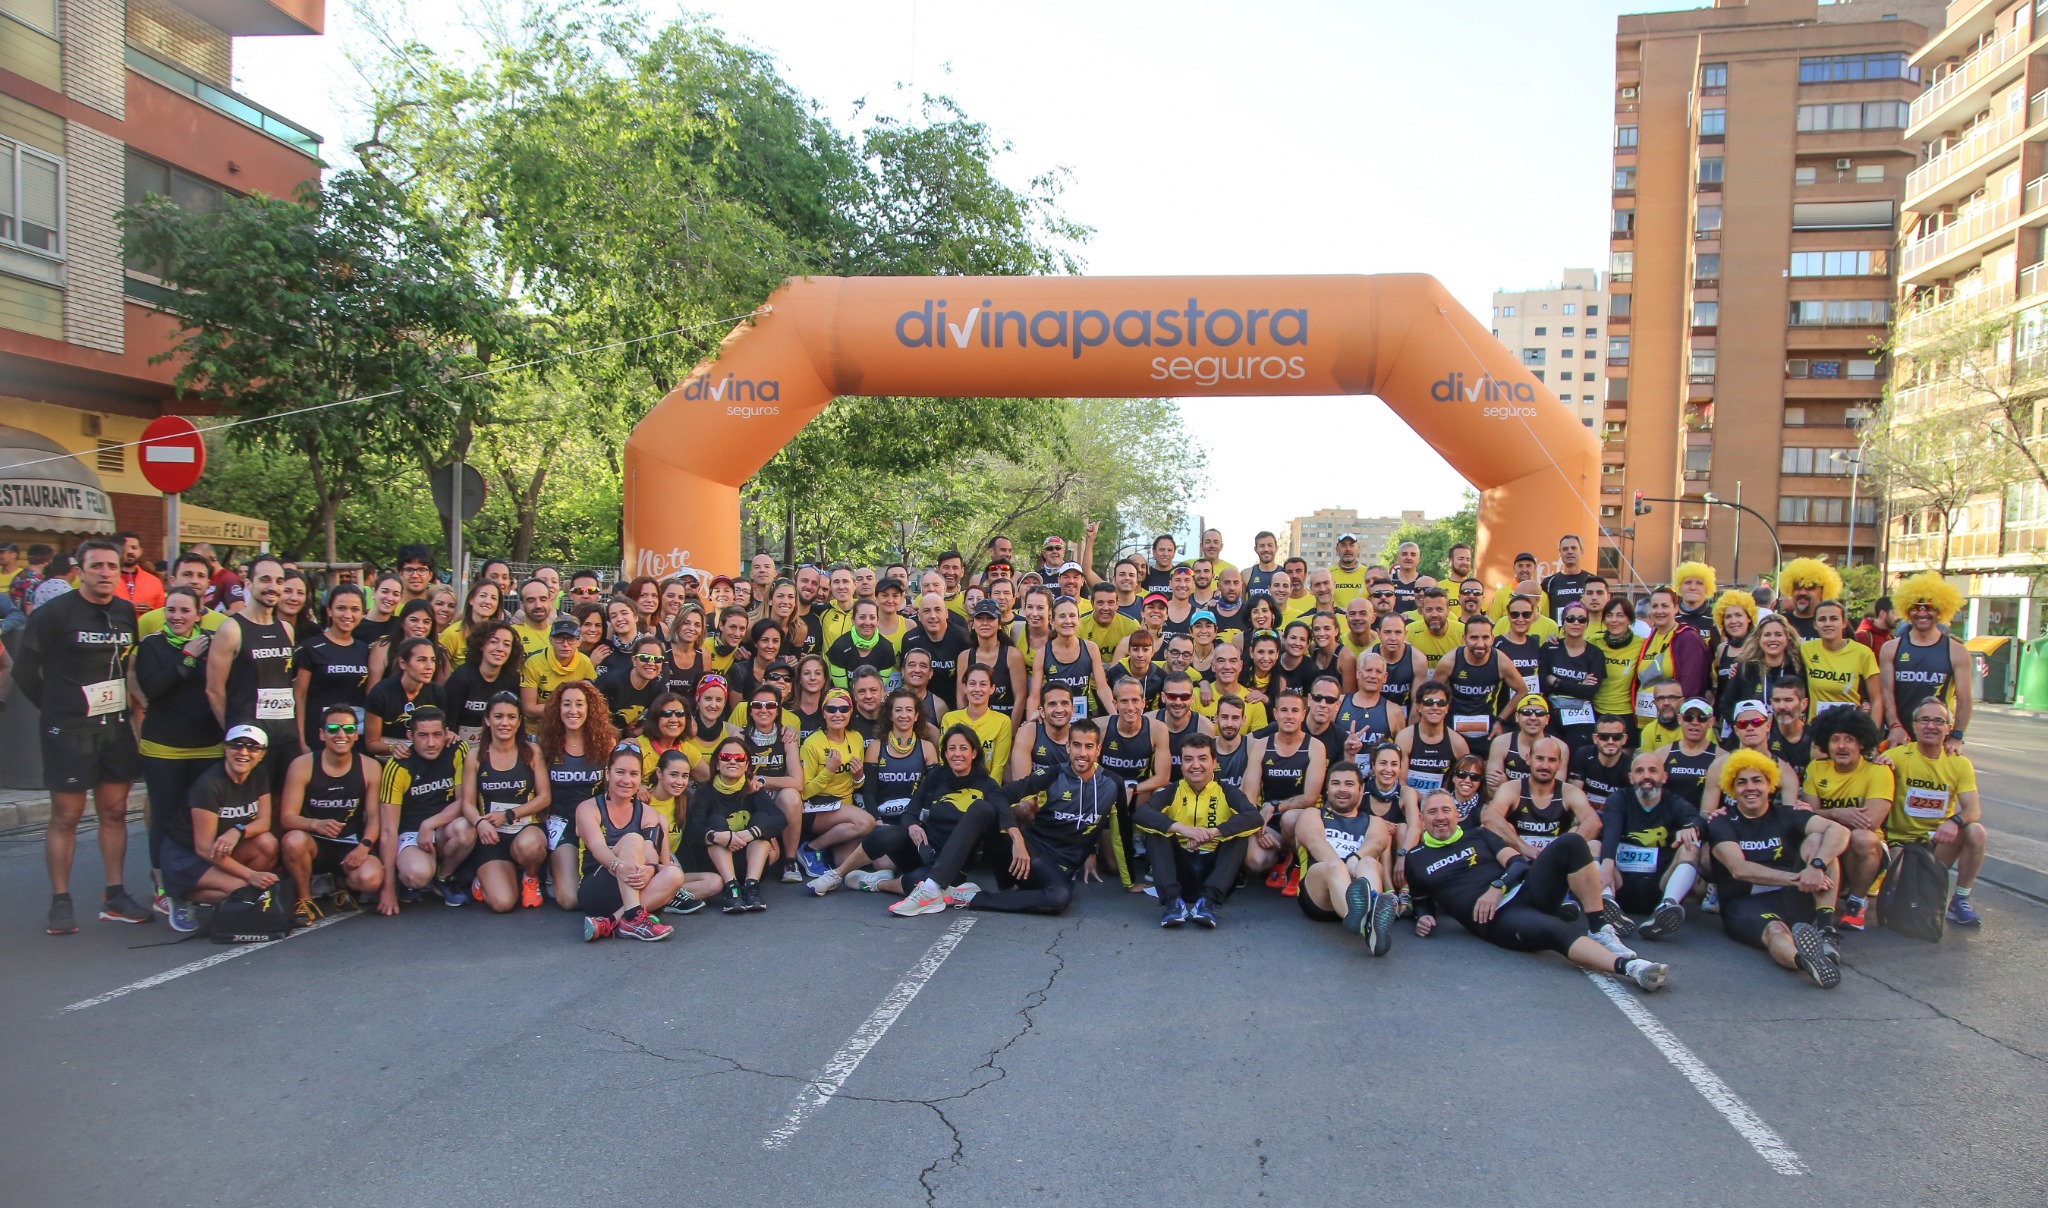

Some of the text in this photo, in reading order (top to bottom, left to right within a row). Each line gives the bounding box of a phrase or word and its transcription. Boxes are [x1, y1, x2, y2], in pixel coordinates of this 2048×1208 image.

[895, 298, 1308, 359] divinapastora
[1150, 355, 1306, 386] seguros
[684, 372, 780, 401] divina
[1431, 372, 1536, 402] divina
[726, 405, 780, 419] seguros
[1483, 406, 1537, 420] seguros
[224, 523, 255, 539] FELIX
[1896, 670, 1944, 684] REDOLAT
[101, 690, 115, 702] 51
[1568, 708, 1590, 717] 6926
[1102, 754, 1149, 769] REDOLAT
[551, 768, 604, 782] REDOLAT
[1268, 768, 1302, 778] REDOLAT
[1671, 766, 1706, 776] REDOLAT
[410, 776, 455, 796] REDOLAT
[482, 778, 527, 791] REDOLAT
[1411, 780, 1438, 789] 3011
[1913, 798, 1941, 809] 2253
[1426, 847, 1474, 875] REDOLAT
[1622, 851, 1651, 862] 2912
